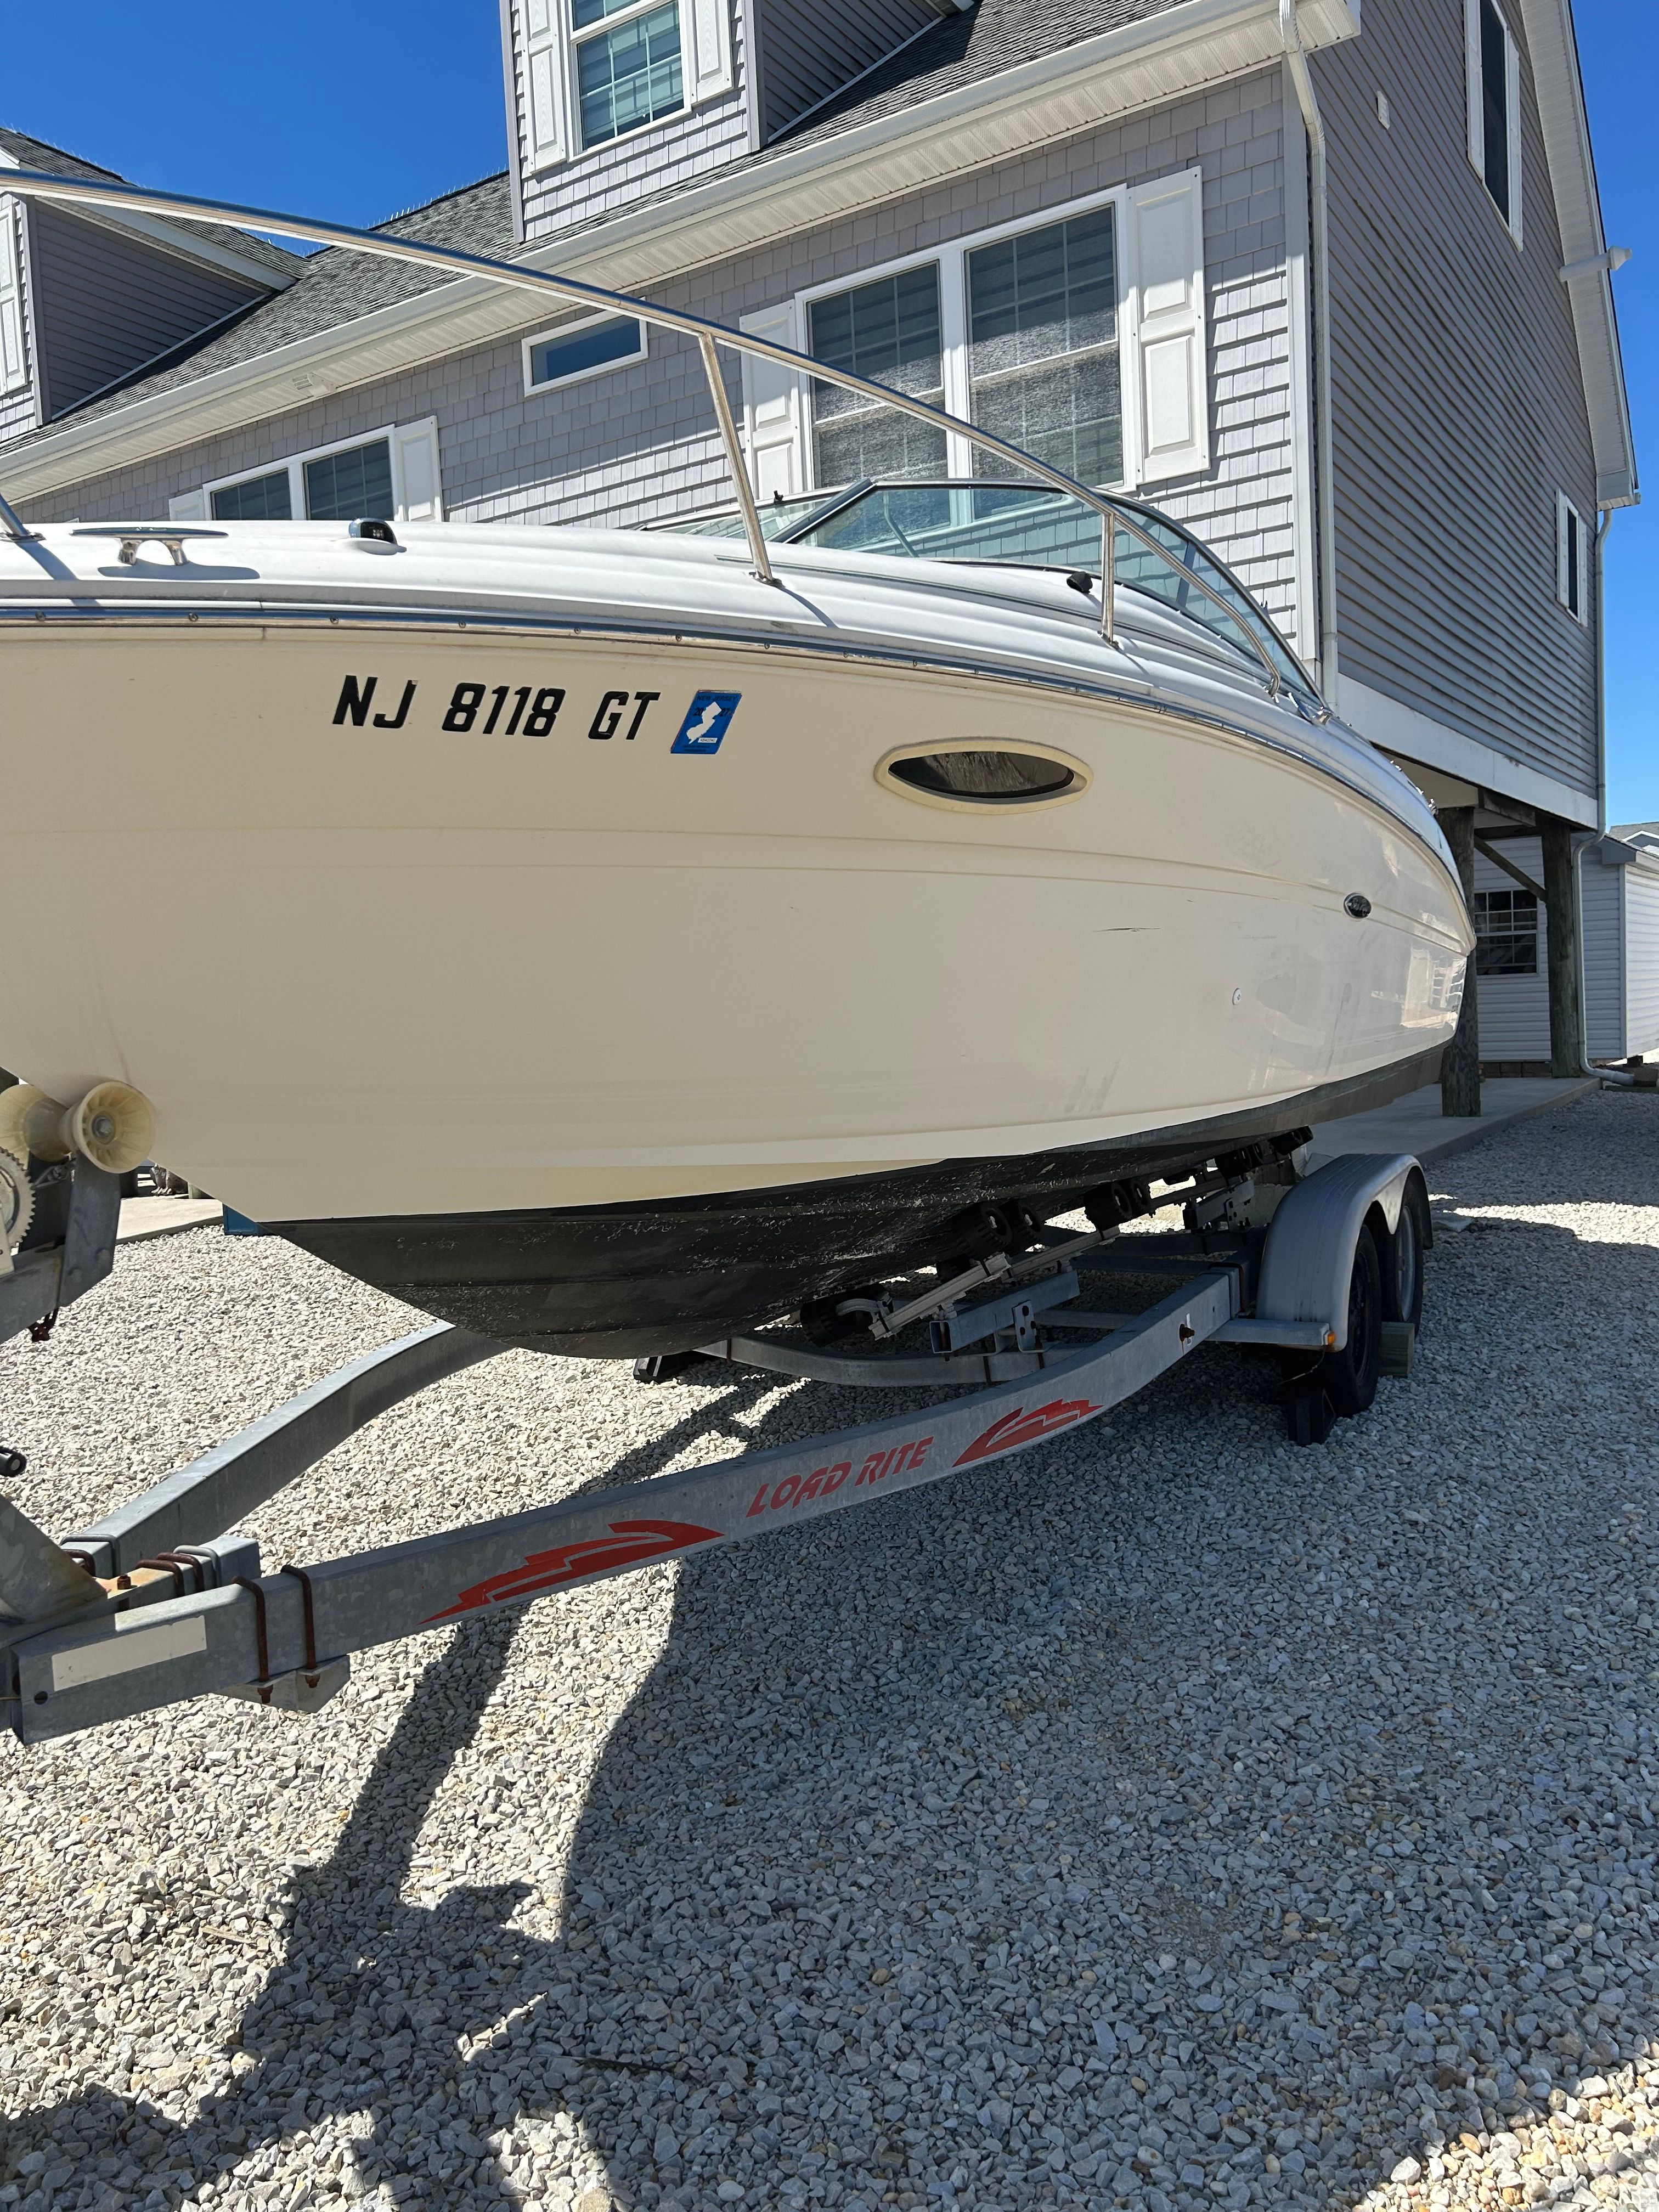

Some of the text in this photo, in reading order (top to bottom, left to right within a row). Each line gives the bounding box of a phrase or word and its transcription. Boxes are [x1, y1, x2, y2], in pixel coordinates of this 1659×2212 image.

[332, 675, 661, 740] NJ 8118 GT
[720, 707, 730, 716] 27
[746, 1436, 934, 1517] LOAD RITE
